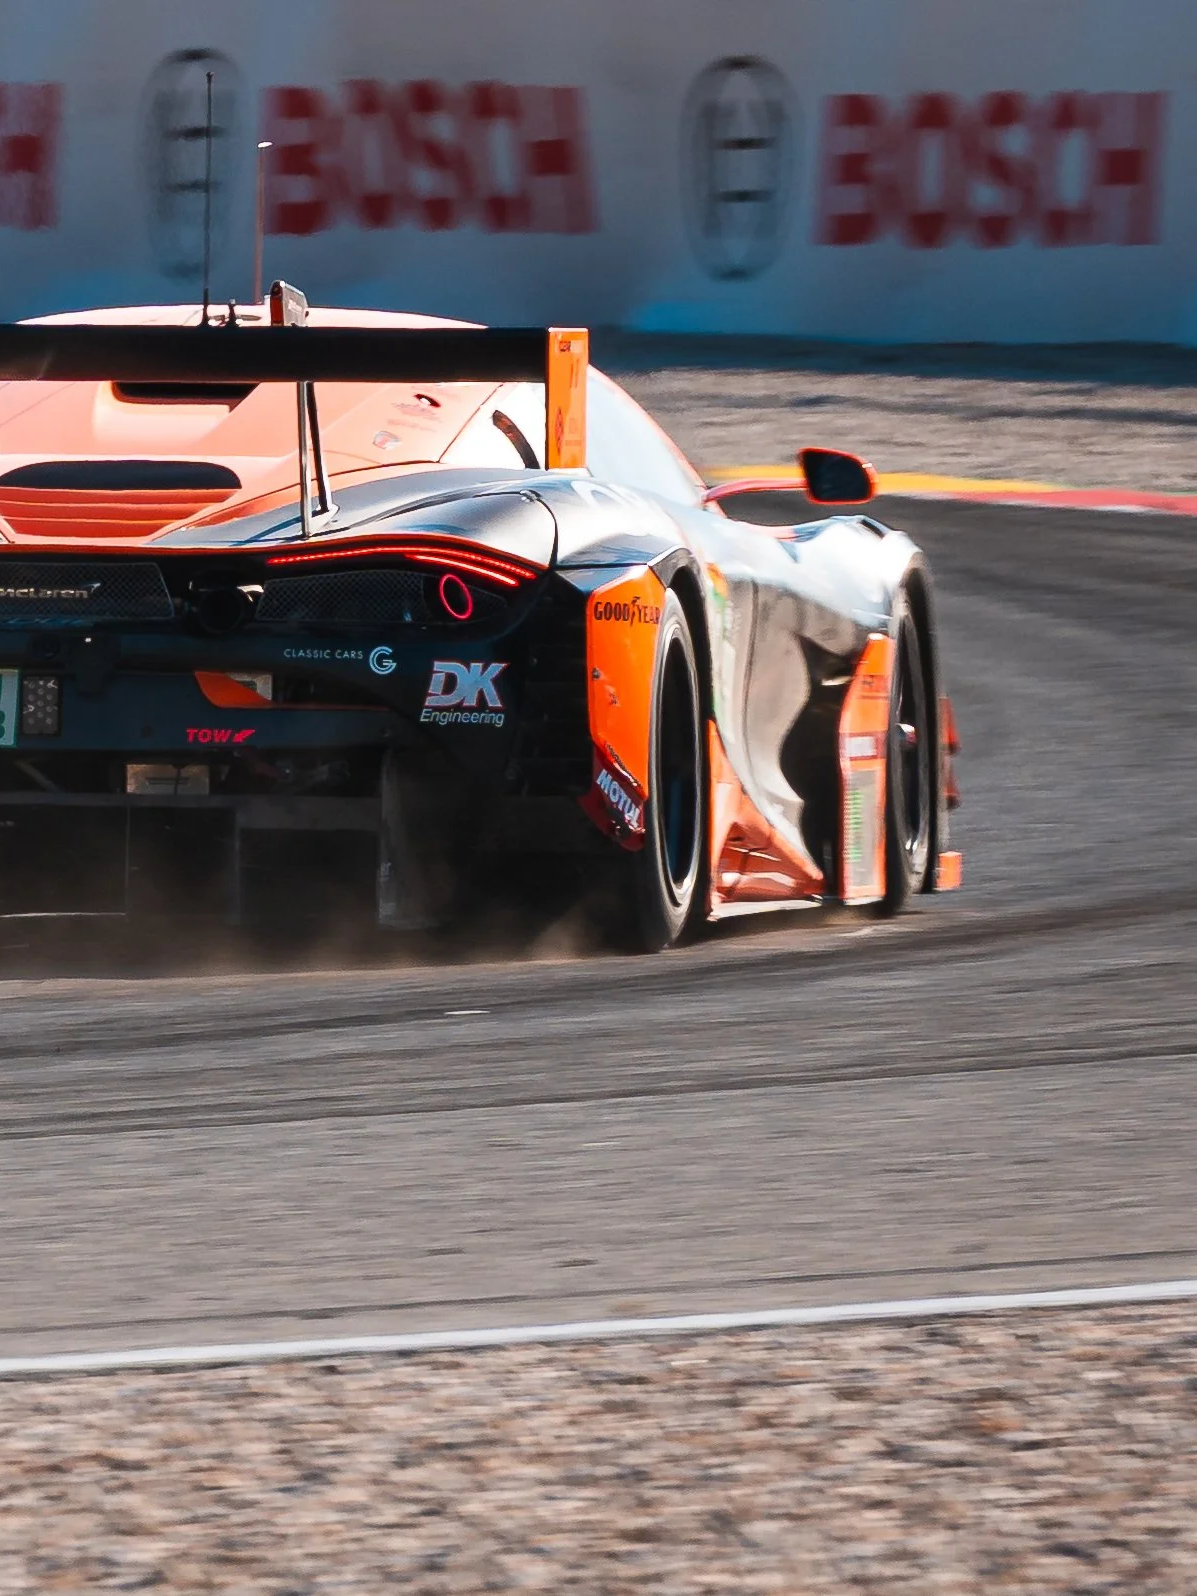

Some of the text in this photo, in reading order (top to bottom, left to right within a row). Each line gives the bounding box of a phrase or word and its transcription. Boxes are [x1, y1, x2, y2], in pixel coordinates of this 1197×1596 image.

[259, 79, 599, 236] BOSCH
[813, 91, 1173, 248] BOSCH
[283, 648, 331, 659] CLASSIC
[335, 649, 363, 660] CARS
[424, 660, 510, 707] DK
[186, 728, 232, 743] TOW
[420, 708, 505, 727] Engineering
[596, 768, 641, 828] MOTUL
